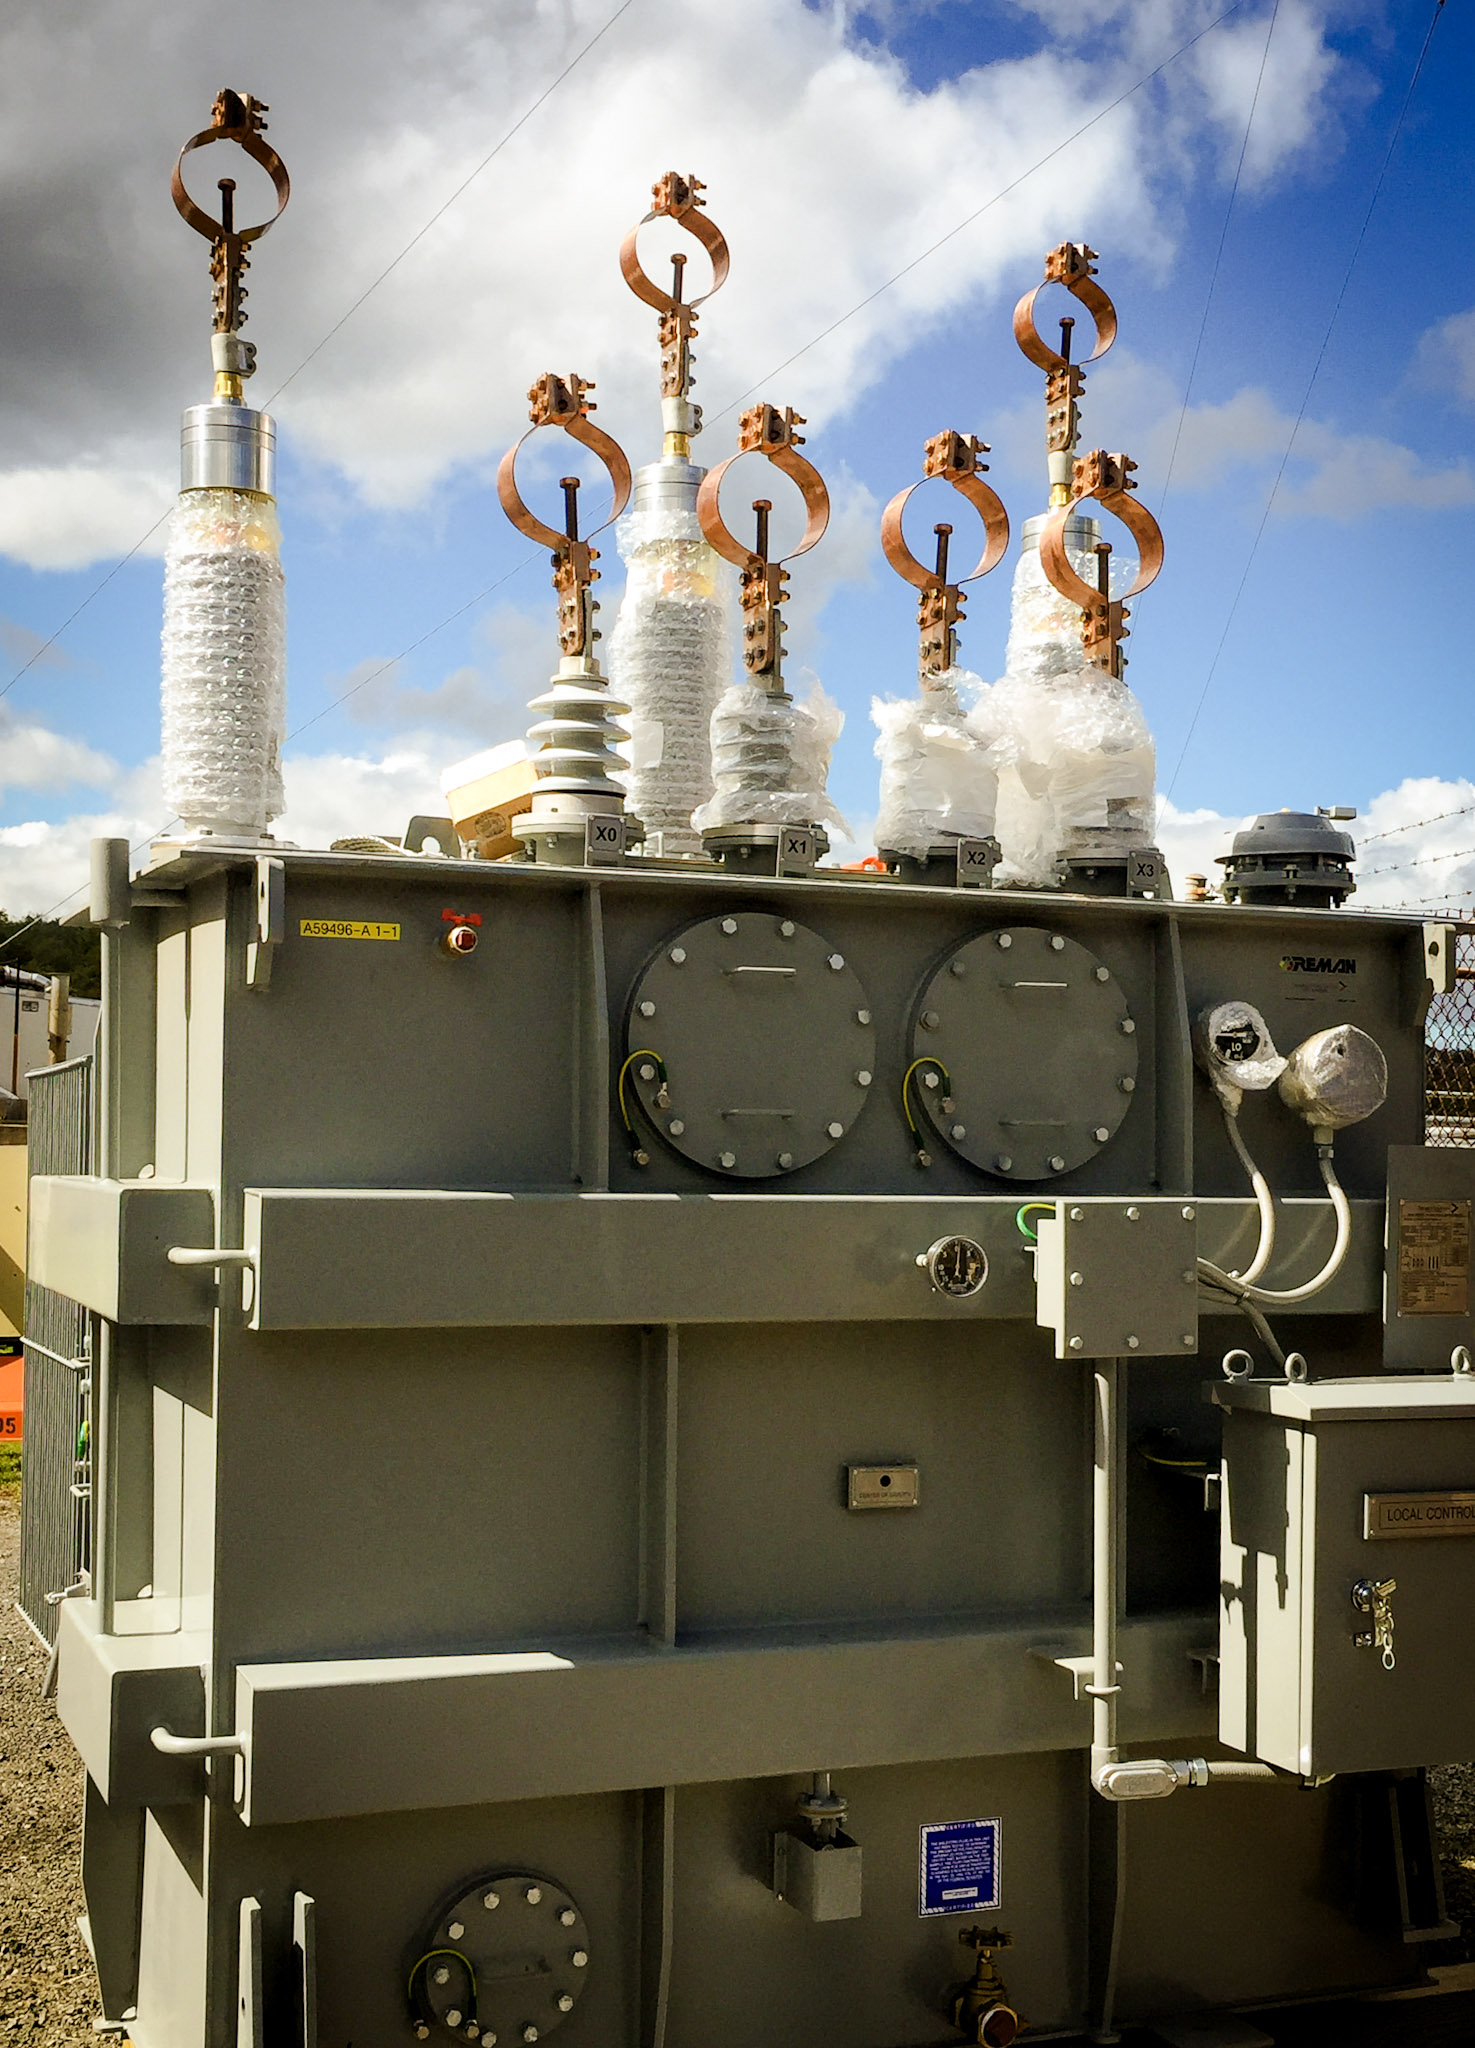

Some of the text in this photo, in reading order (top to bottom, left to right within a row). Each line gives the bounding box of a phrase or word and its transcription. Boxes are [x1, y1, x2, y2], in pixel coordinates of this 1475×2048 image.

[595, 826, 617, 842] X0
[787, 838, 806, 854] X1
[967, 850, 986, 866] X2
[1136, 863, 1154, 877] X3
[303, 922, 371, 936] A59496-A
[1291, 956, 1356, 974] REMAN
[1387, 1508, 1423, 1521] LOCAL
